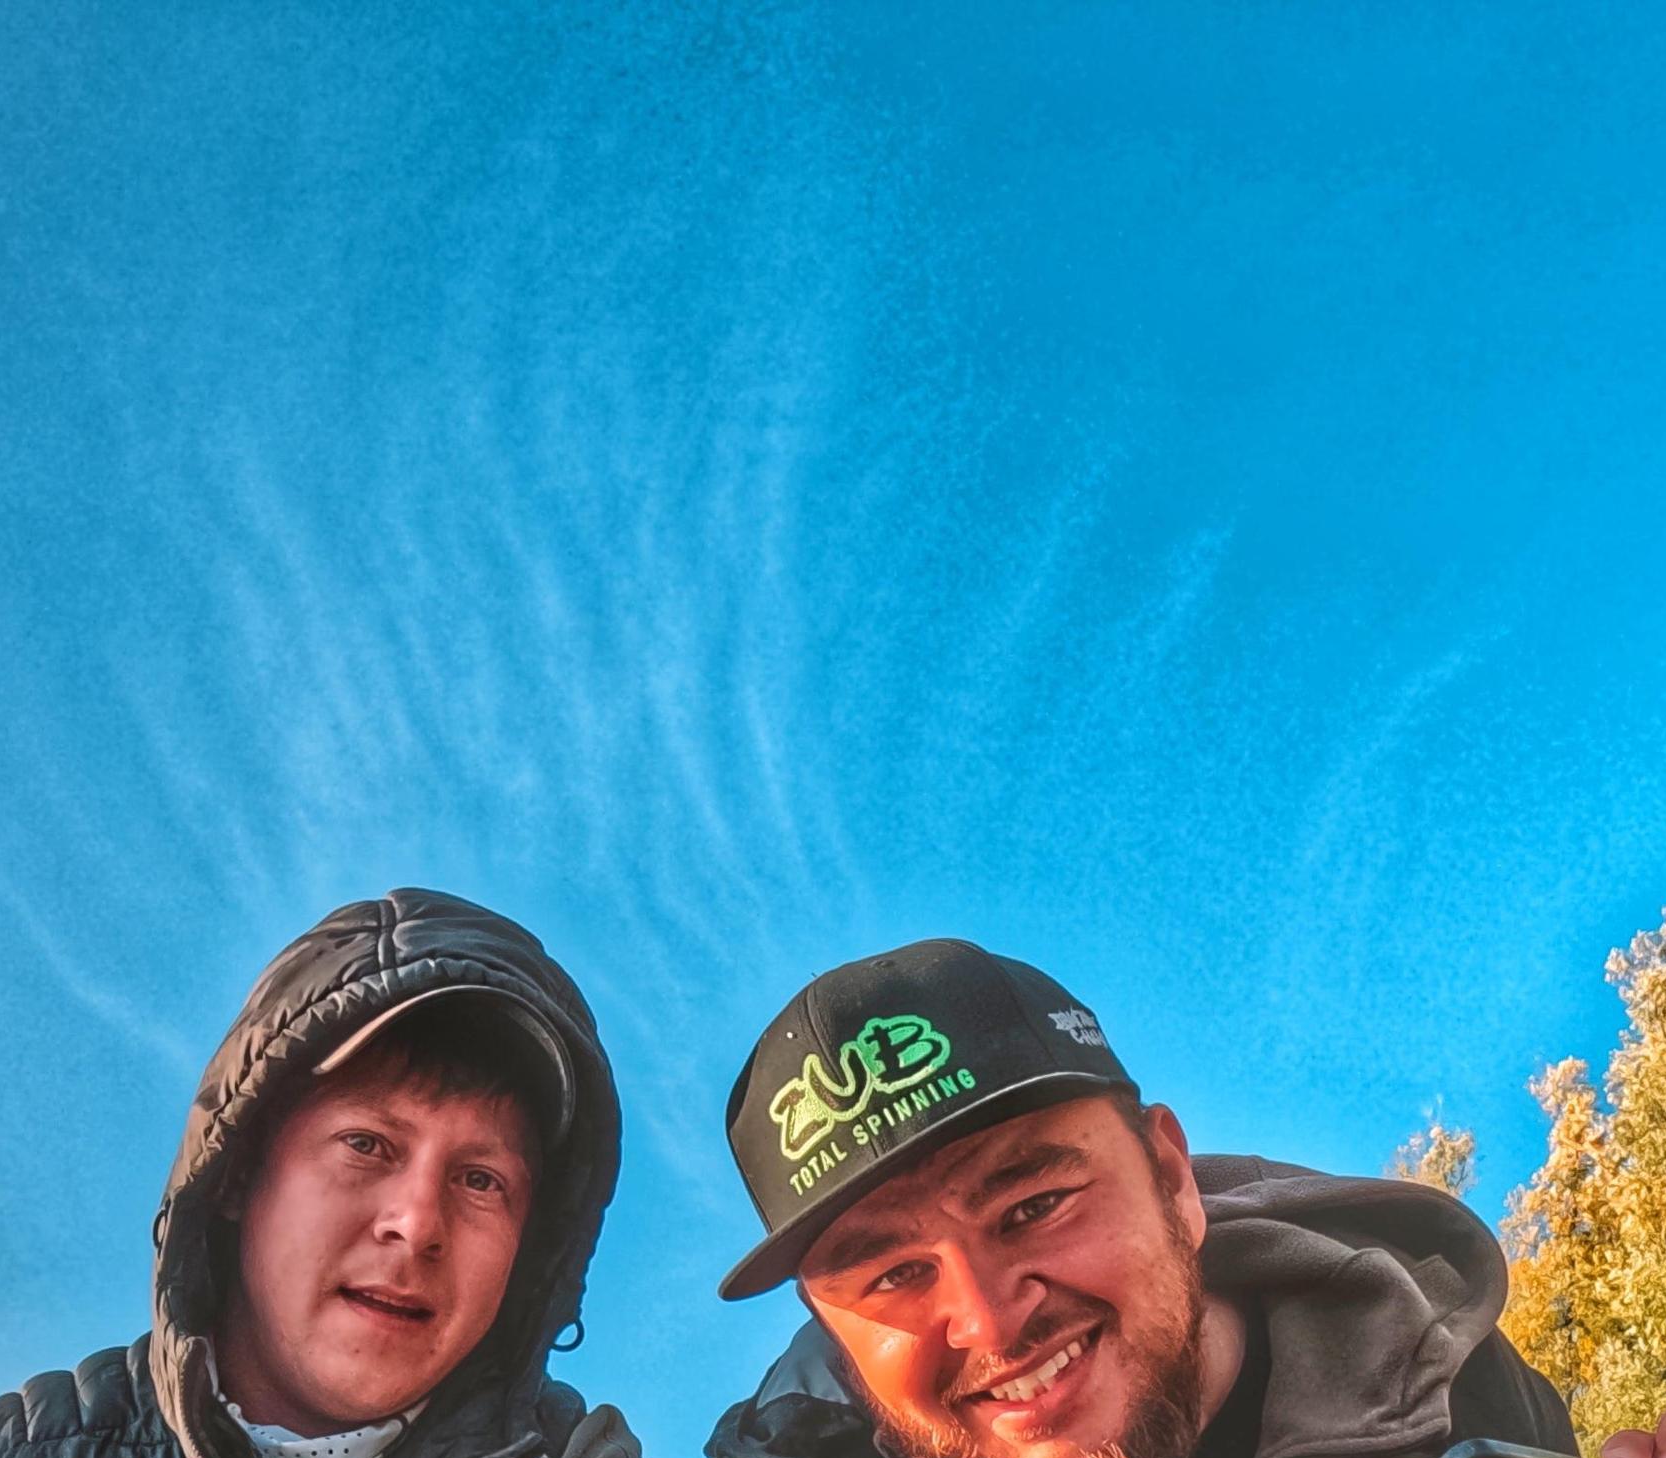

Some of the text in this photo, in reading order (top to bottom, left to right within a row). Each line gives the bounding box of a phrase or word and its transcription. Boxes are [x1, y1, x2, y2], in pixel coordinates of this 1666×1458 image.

[769, 1015, 951, 1160] ZUB
[789, 1068, 976, 1196] TOTAL SPINNING
